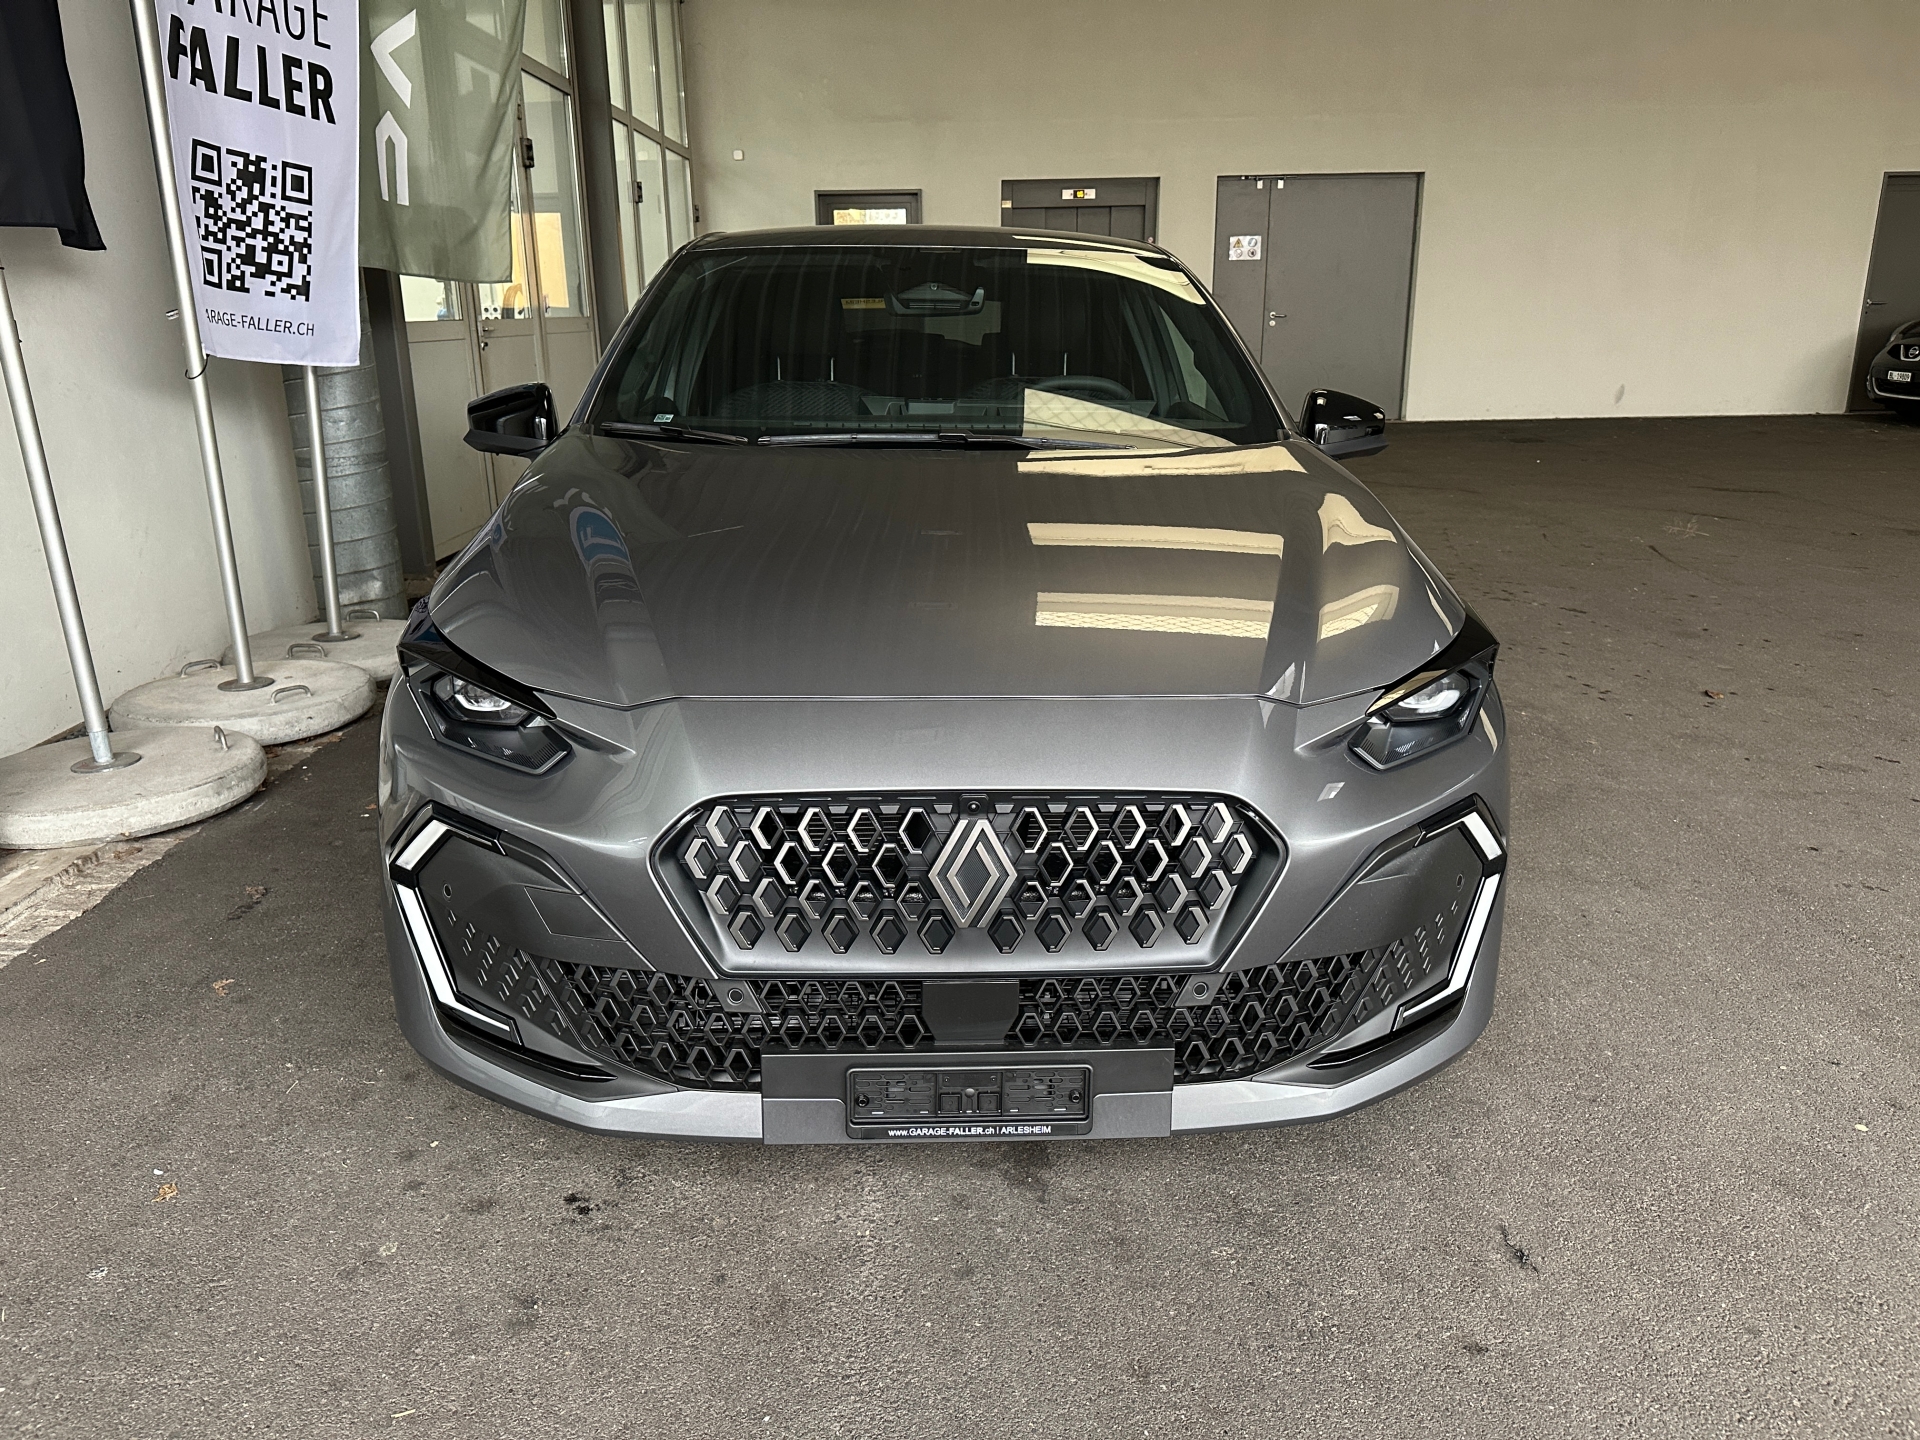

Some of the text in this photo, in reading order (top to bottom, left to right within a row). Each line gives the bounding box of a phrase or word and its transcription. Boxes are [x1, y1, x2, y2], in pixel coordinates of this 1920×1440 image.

[167, 13, 336, 125] FALLER
[888, 1126, 994, 1136] www.GARAGE-FALLER.ch
[1001, 1125, 1051, 1135] ARLESHEIM
